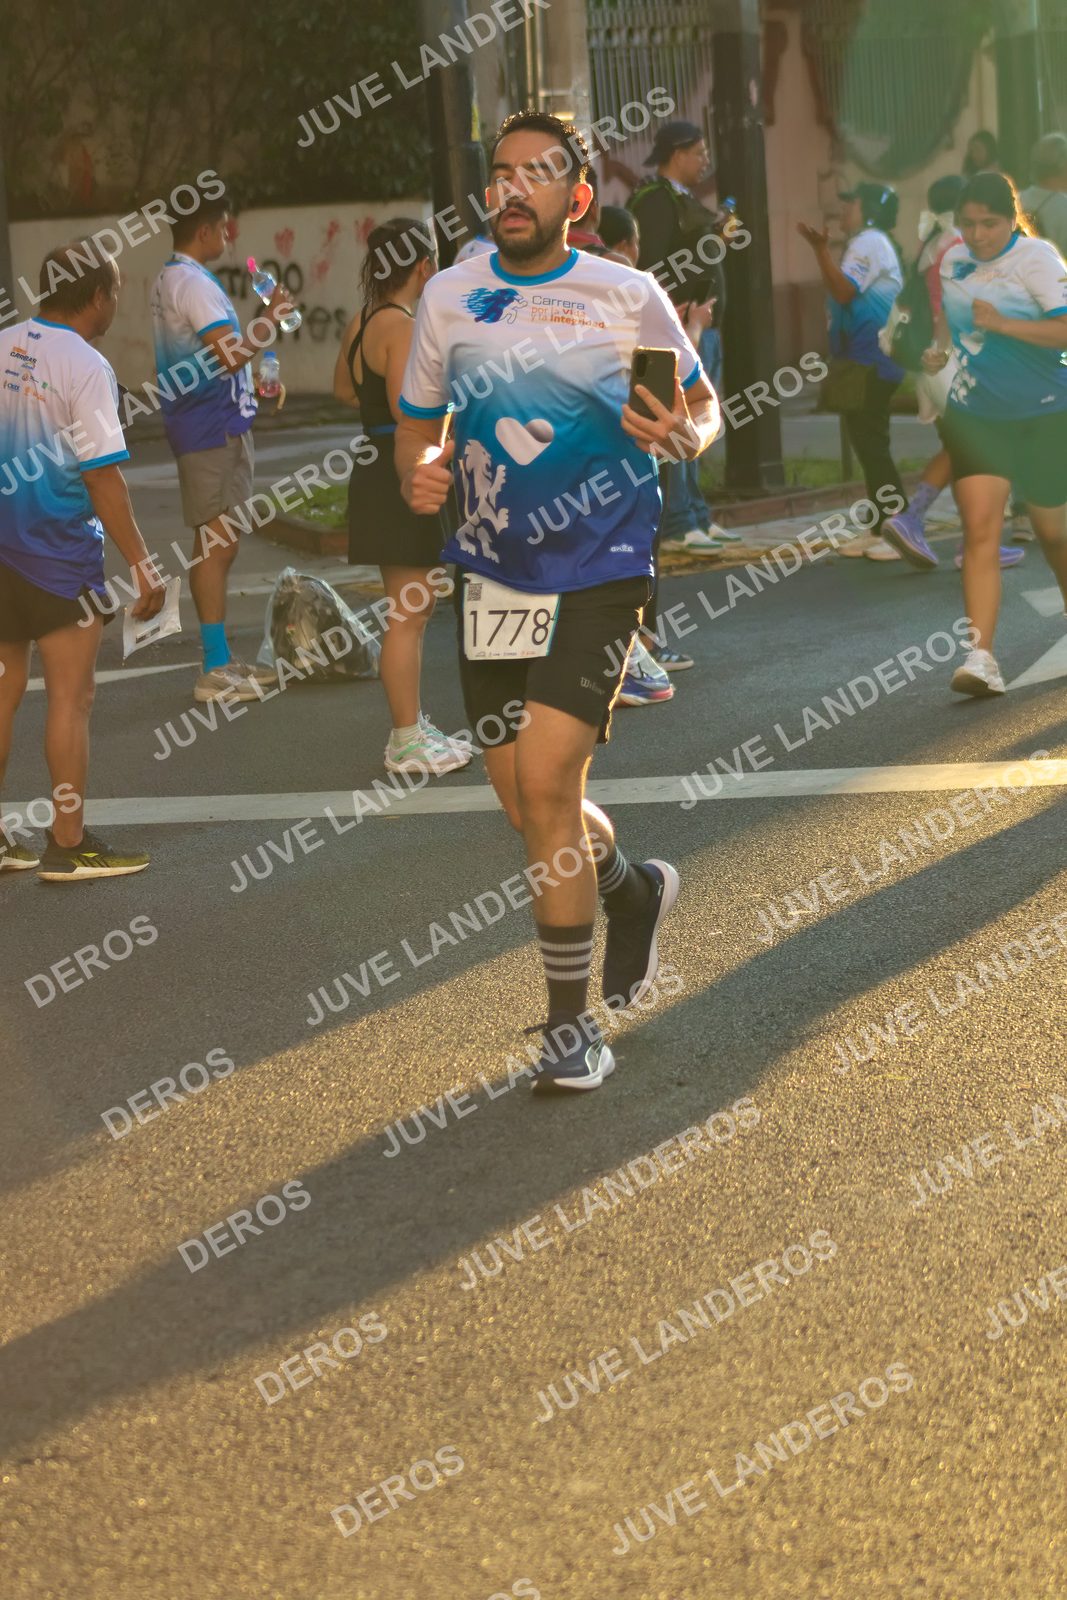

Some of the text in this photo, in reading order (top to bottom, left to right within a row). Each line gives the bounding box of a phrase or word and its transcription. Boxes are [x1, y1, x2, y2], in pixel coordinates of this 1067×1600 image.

[532, 295, 585, 310] Carrera
[532, 307, 548, 316] por
[550, 314, 606, 329] integridad
[469, 608, 551, 647] 1778
